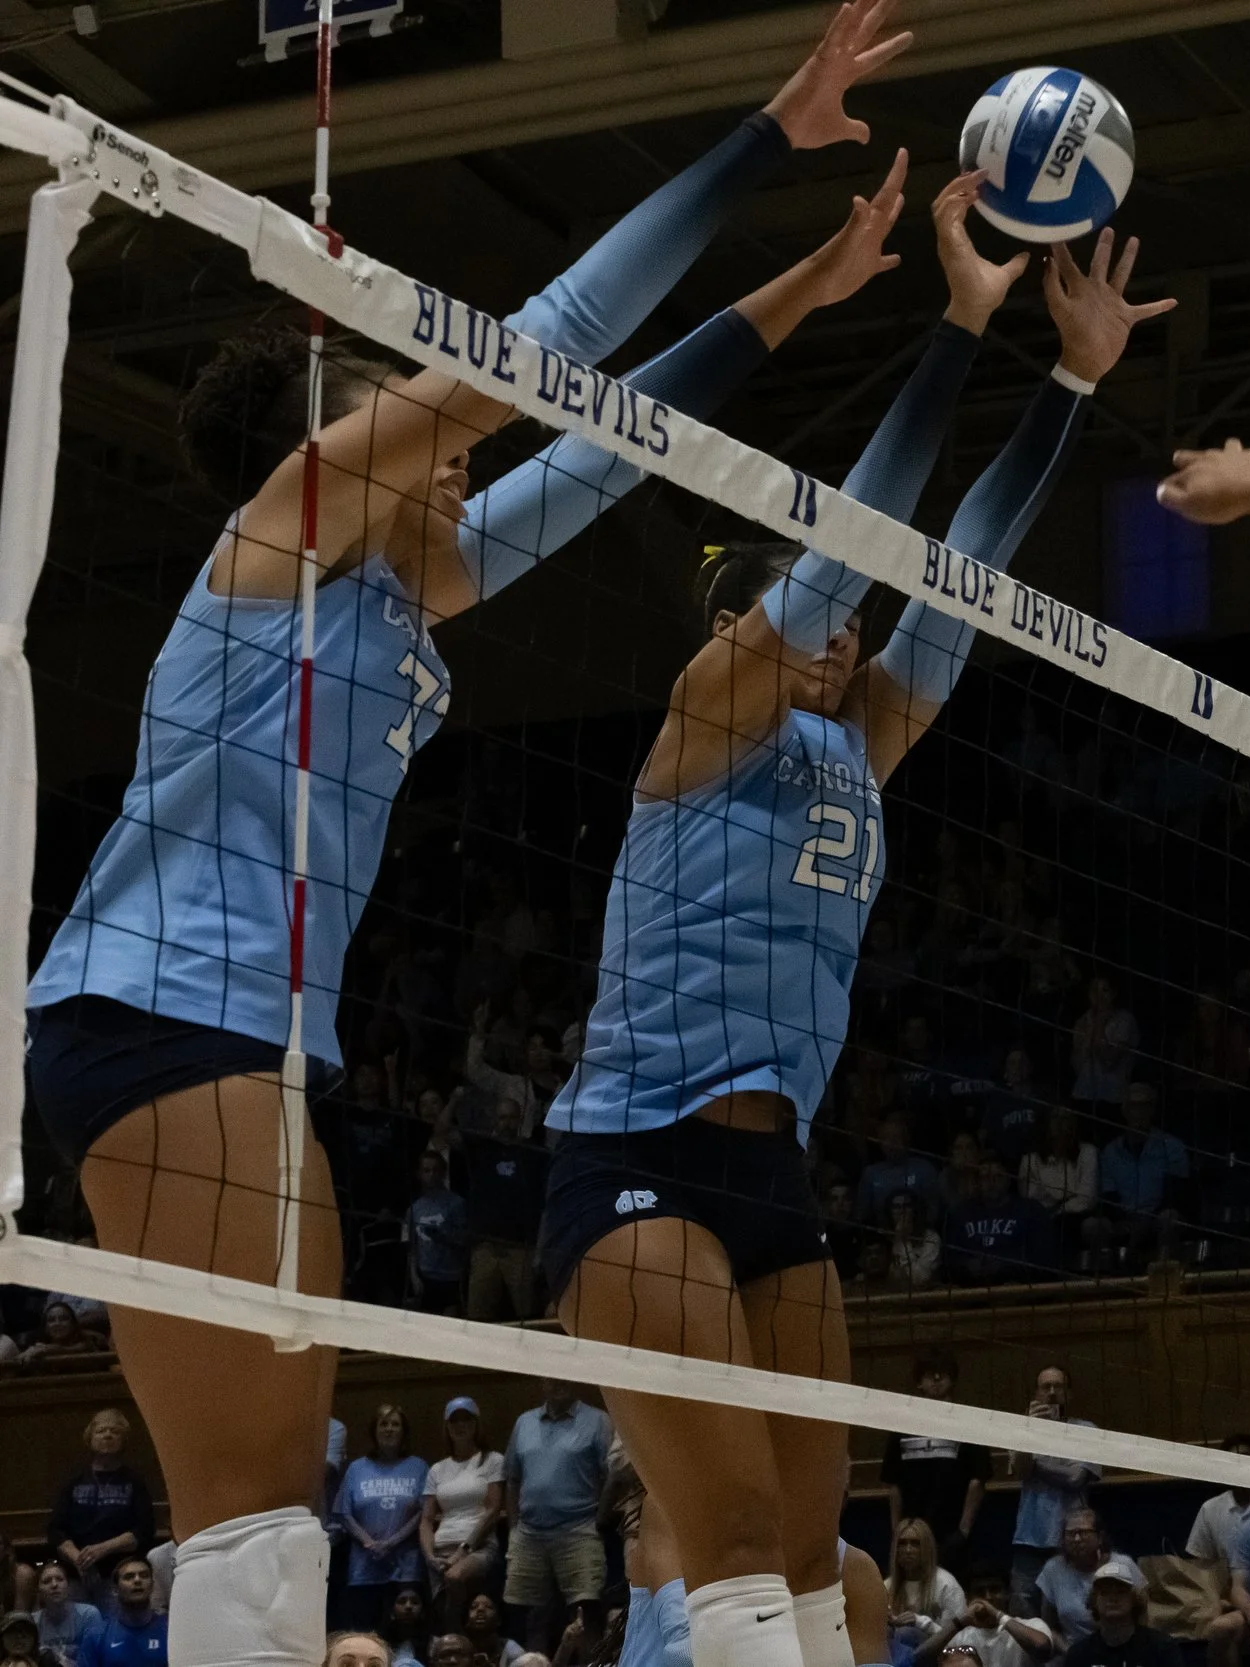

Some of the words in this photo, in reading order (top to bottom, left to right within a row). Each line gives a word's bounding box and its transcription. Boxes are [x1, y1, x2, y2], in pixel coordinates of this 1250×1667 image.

[106, 133, 150, 168] Senoh
[1045, 91, 1097, 179] molten
[412, 282, 518, 385] BLUE
[536, 345, 669, 457] DEVILS
[922, 535, 999, 617] BLUE
[1011, 579, 1108, 668] DEVILS
[791, 799, 880, 904] 21
[965, 1218, 1018, 1239] DUKE
